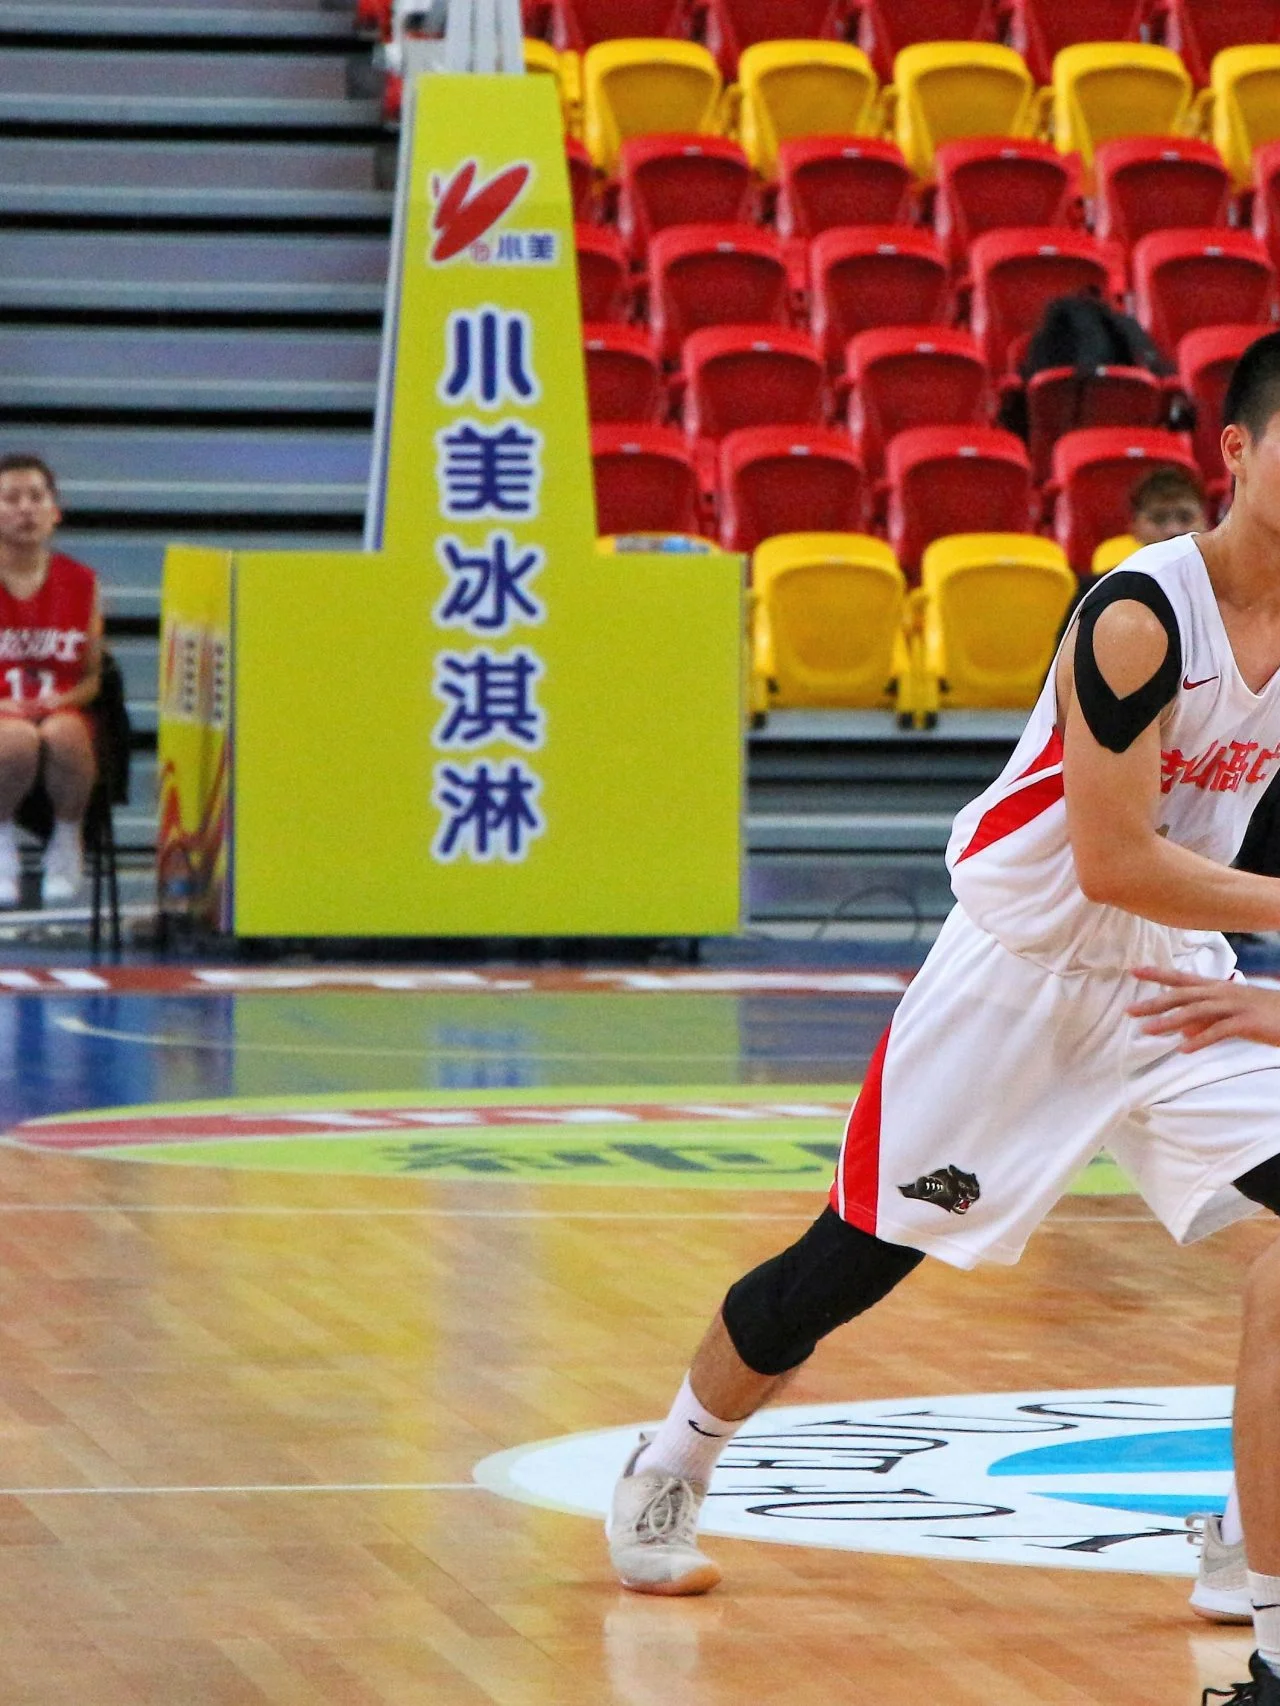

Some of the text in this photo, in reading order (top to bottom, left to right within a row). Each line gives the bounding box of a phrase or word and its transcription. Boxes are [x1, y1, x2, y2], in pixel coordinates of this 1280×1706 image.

[497, 234, 554, 261] 小美
[439, 311, 539, 856] 小美冰淇淋
